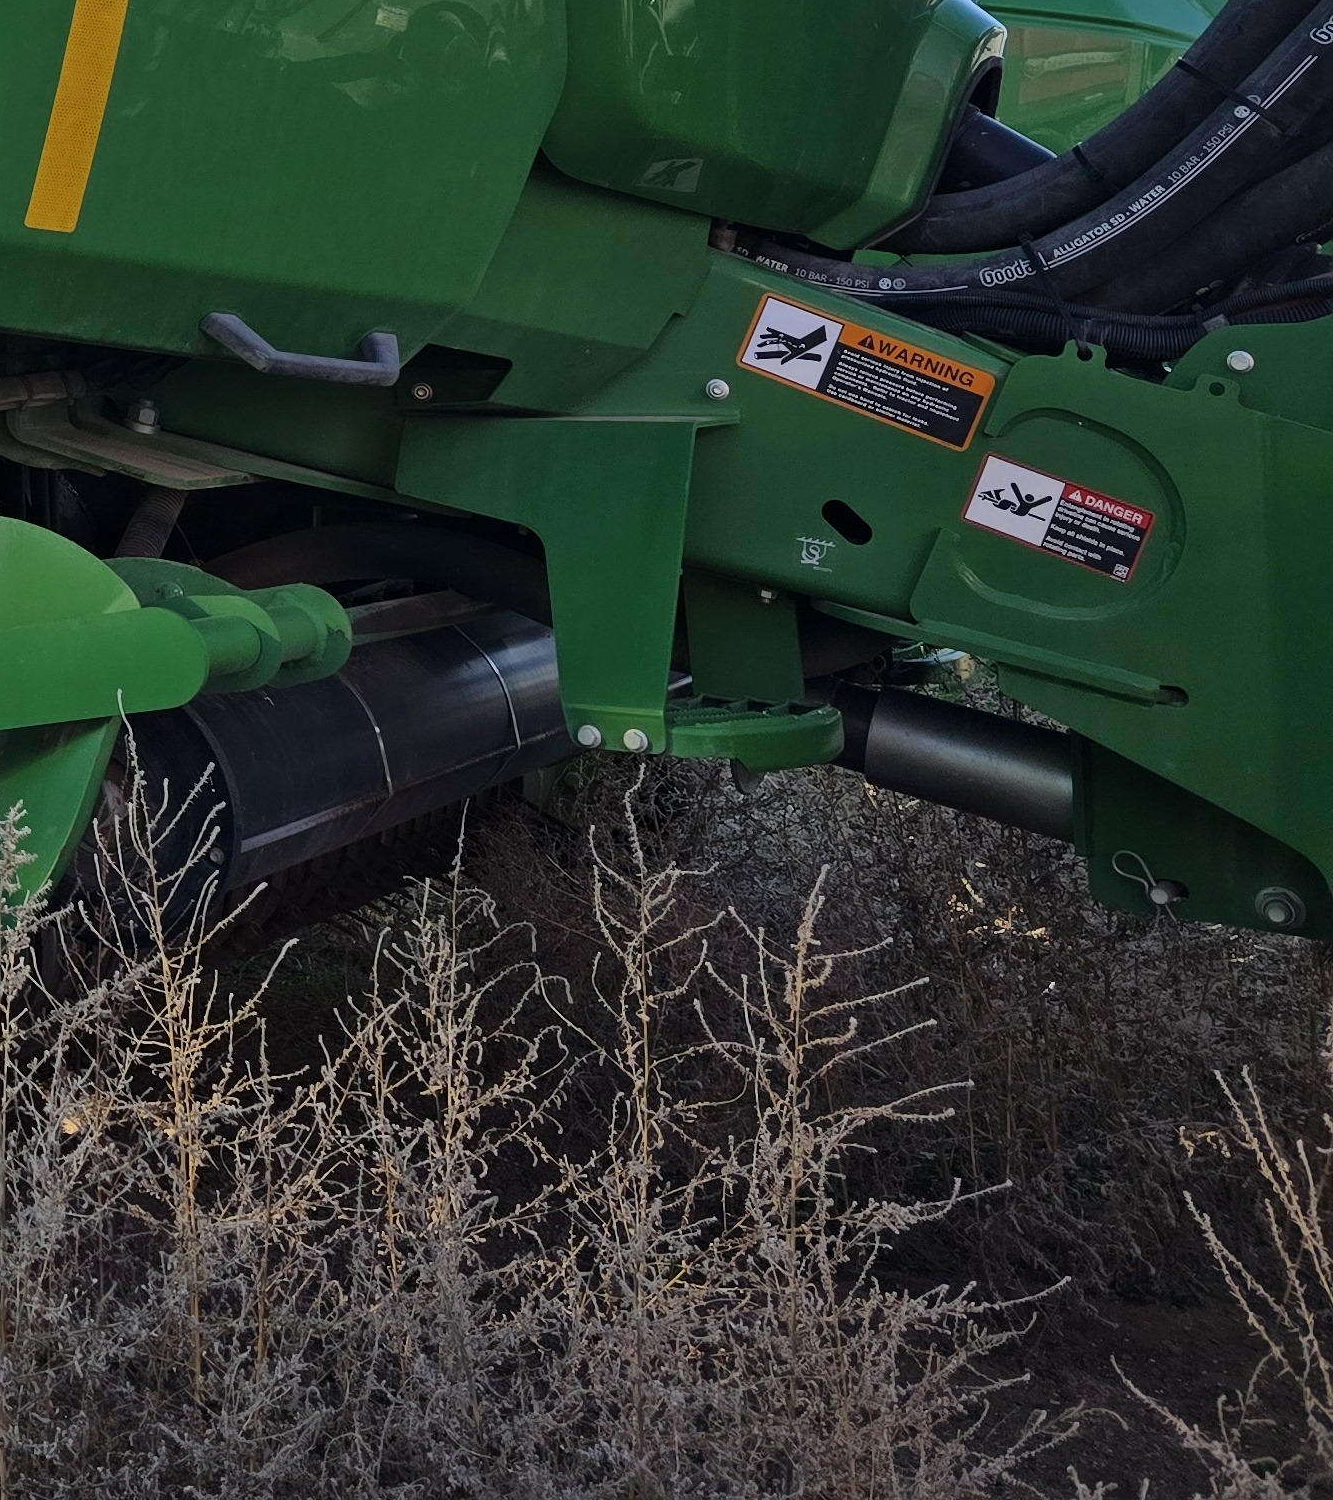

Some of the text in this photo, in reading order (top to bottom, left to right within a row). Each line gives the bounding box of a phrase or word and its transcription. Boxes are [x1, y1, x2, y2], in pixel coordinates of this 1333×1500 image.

[1052, 221, 1112, 259] ALLIGATOR
[1109, 211, 1127, 228] SD
[1128, 184, 1167, 215] WATER
[1167, 170, 1183, 185] 10
[1180, 154, 1201, 175] BAR
[1202, 135, 1222, 154] 150
[1217, 122, 1236, 140] PSI
[794, 267, 806, 278] 10
[807, 271, 828, 283] BAR
[835, 275, 853, 287] 150
[854, 278, 871, 289] PSI
[844, 350, 860, 359] Avoid
[861, 357, 882, 367] serious
[883, 365, 900, 374] injury
[901, 371, 915, 379] from
[878, 339, 976, 388] WARNING
[838, 362, 858, 372] Always
[906, 387, 925, 397] before
[860, 396, 874, 405] hand
[882, 406, 902, 415] search
[1085, 496, 1144, 524] DANGER
[1046, 536, 1102, 560] Avoid contact with
[1051, 524, 1067, 534] Keep
[1076, 534, 1098, 546] shields
